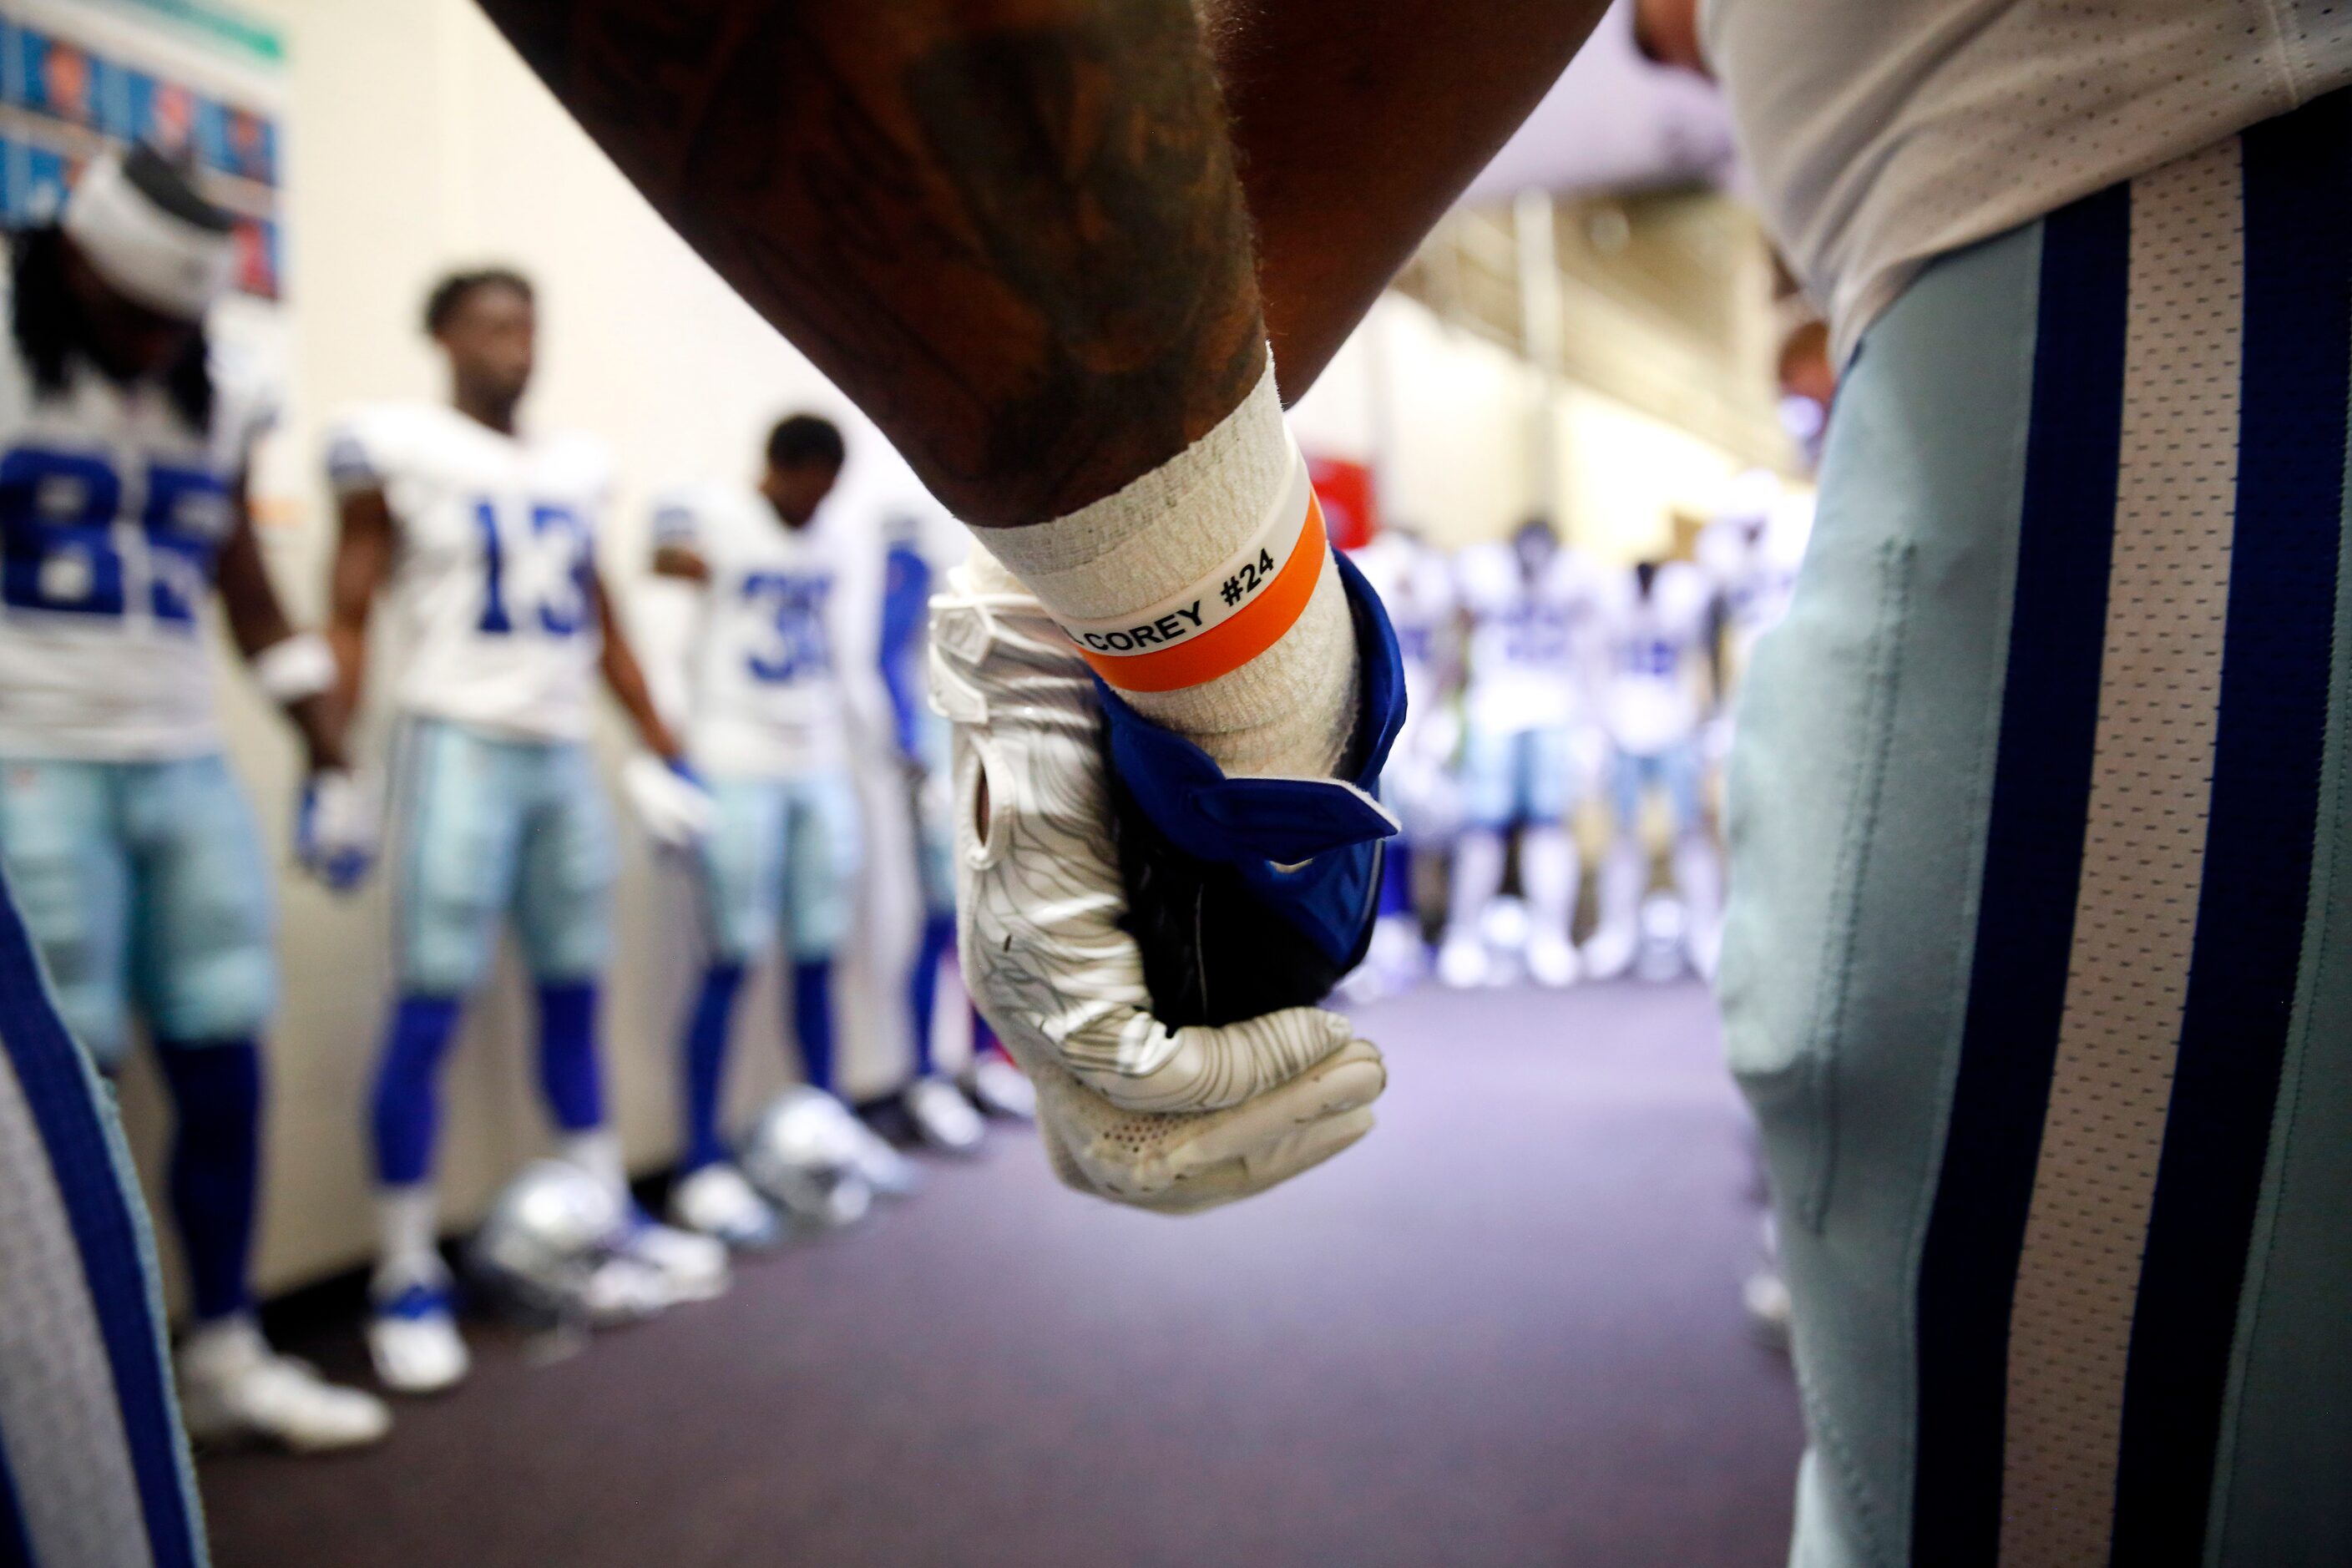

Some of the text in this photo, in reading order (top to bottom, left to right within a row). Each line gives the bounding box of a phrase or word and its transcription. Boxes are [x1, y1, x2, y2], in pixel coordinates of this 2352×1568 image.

[474, 498, 591, 635] 13
[1084, 549, 1274, 650] COREY #24
